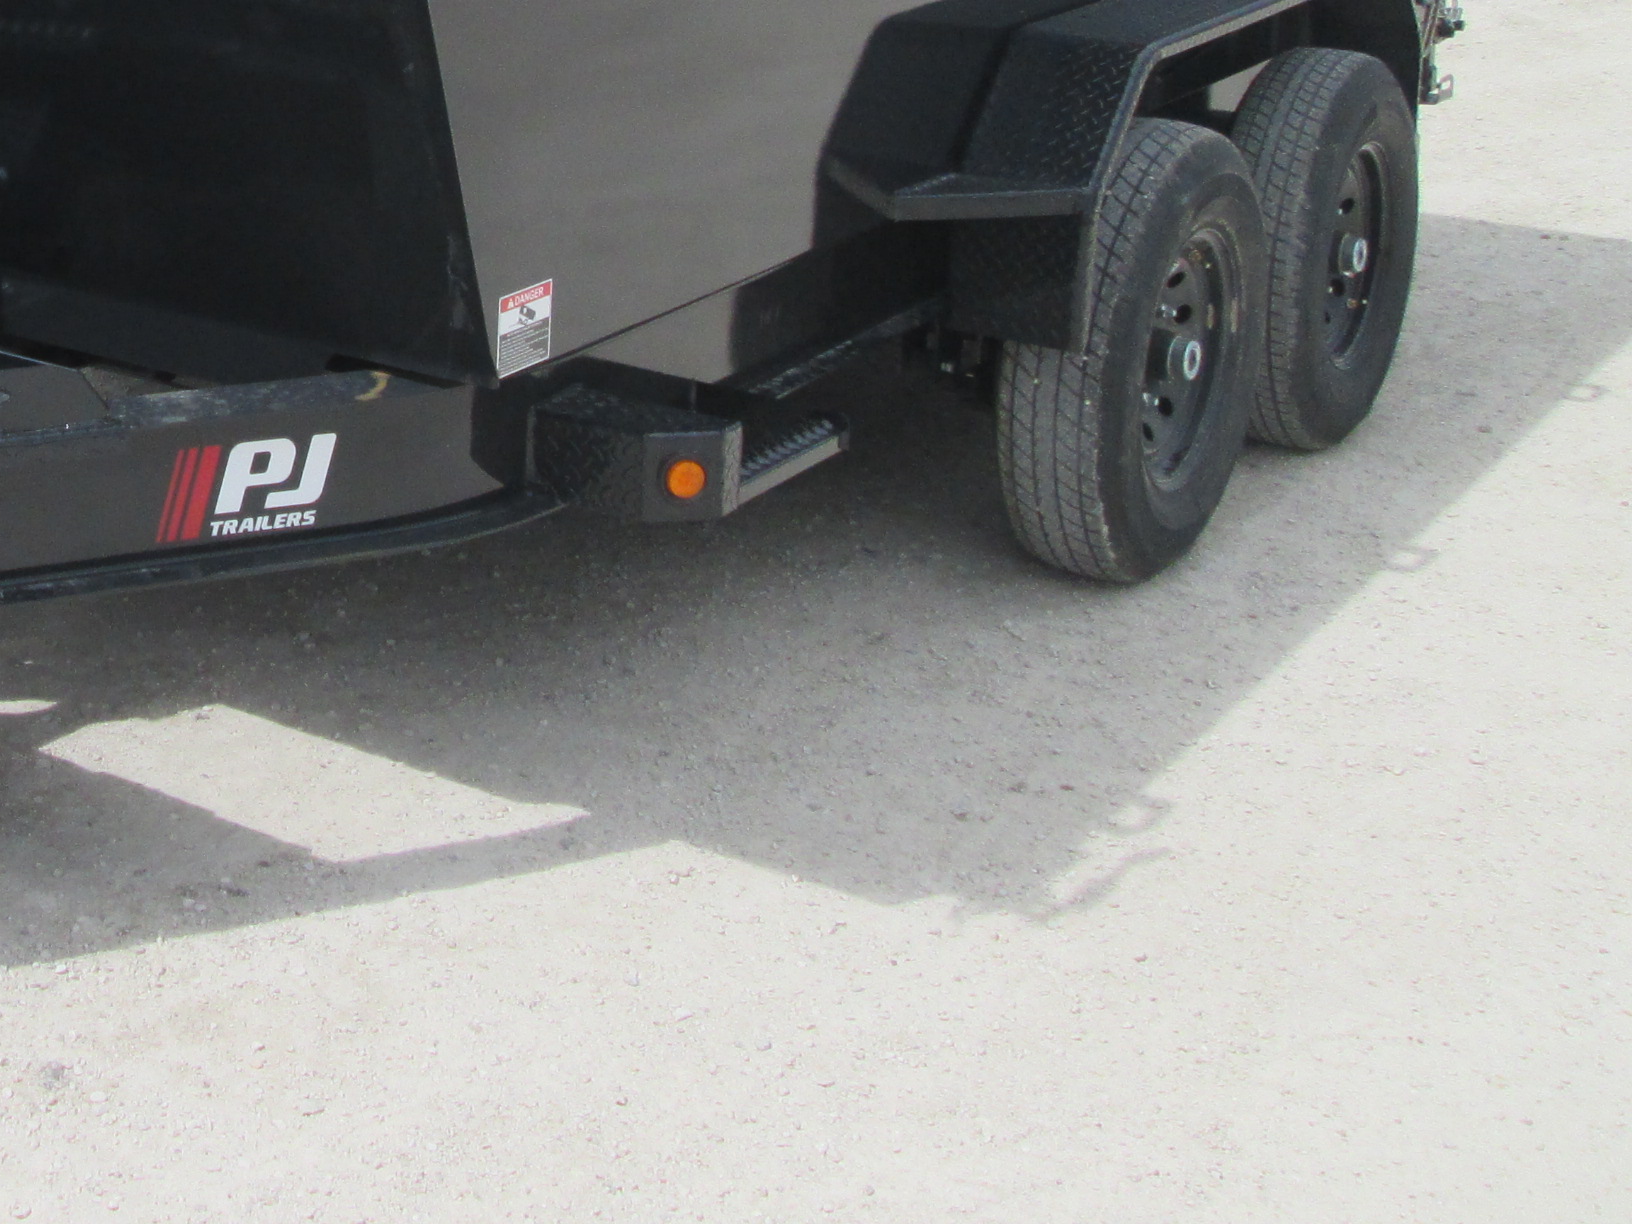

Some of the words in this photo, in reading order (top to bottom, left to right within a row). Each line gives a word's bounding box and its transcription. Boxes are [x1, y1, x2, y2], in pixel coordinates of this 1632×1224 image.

[514, 286, 544, 306] DANGER
[214, 432, 337, 515] PJ
[210, 509, 317, 537] TRAILERS
